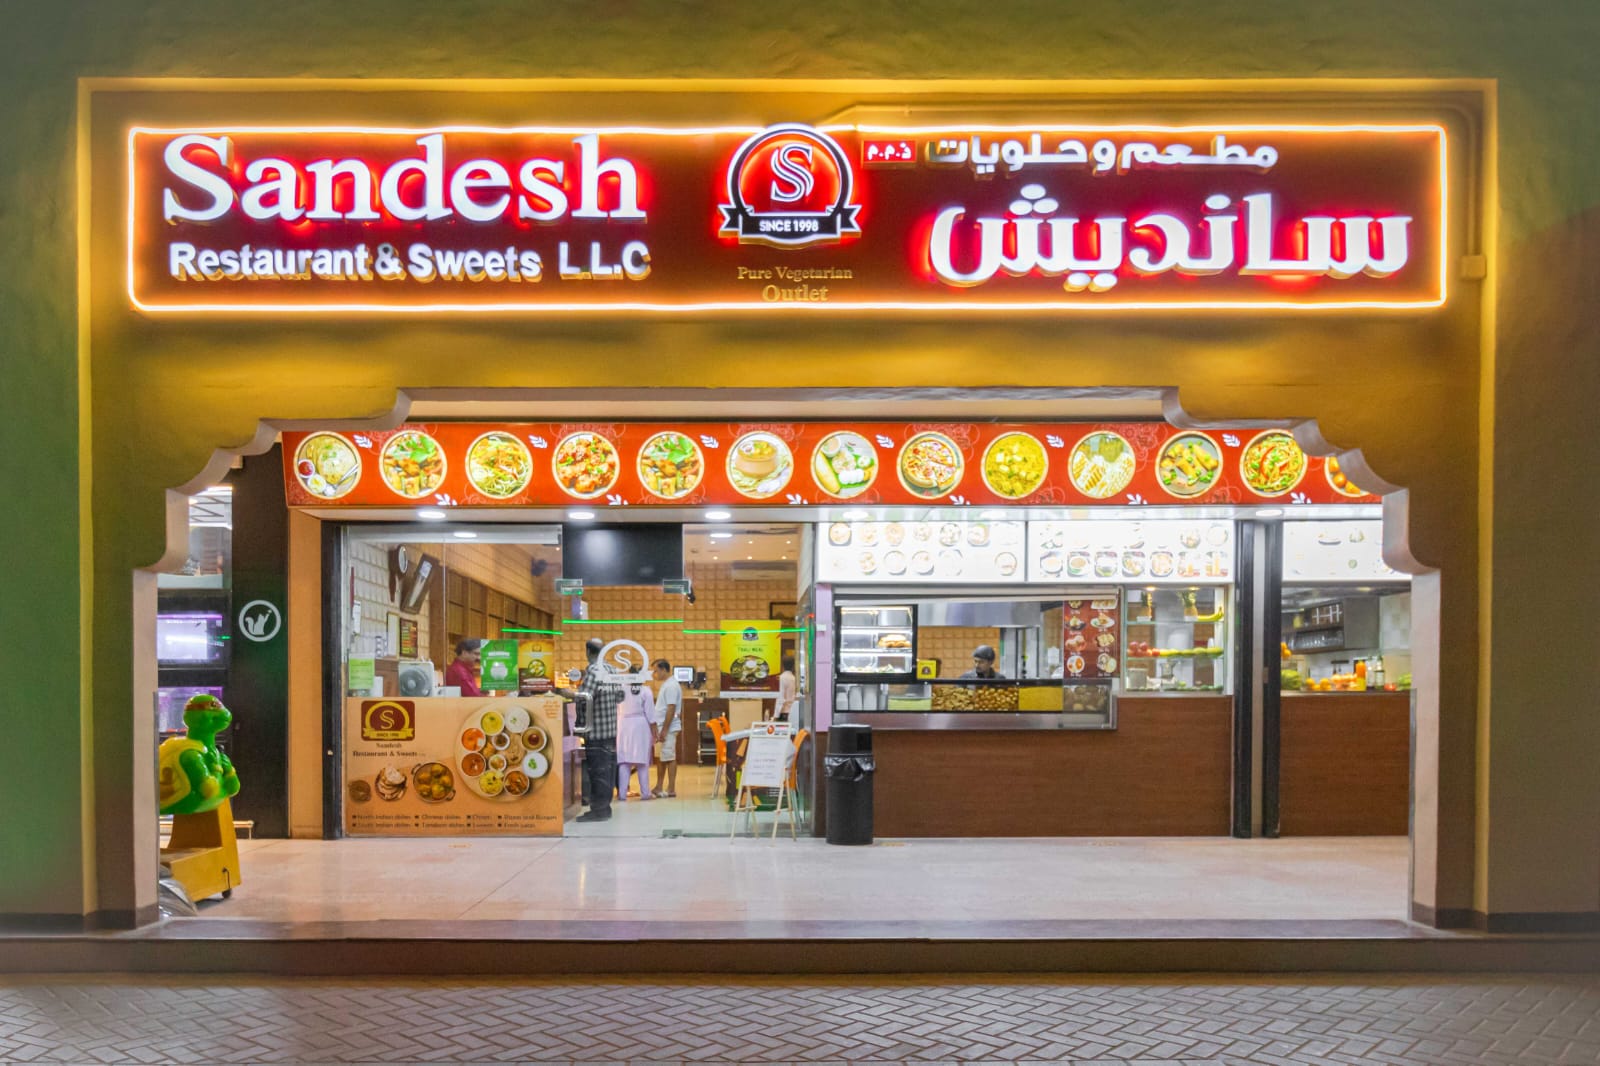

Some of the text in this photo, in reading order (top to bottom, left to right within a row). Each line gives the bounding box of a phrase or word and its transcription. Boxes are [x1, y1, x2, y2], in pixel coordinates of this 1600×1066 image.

[770, 143, 814, 202] S
[926, 133, 1279, 175] مطعم وحلويات
[163, 132, 649, 223] Sandesh
[759, 219, 819, 232] SINCE 1998
[929, 184, 1413, 291] سانديش
[169, 241, 370, 279] Restaurant
[374, 242, 404, 280] &
[407, 243, 542, 281] Sweets
[737, 266, 853, 282] Pure Vegetarian
[762, 284, 828, 302] Outlet
